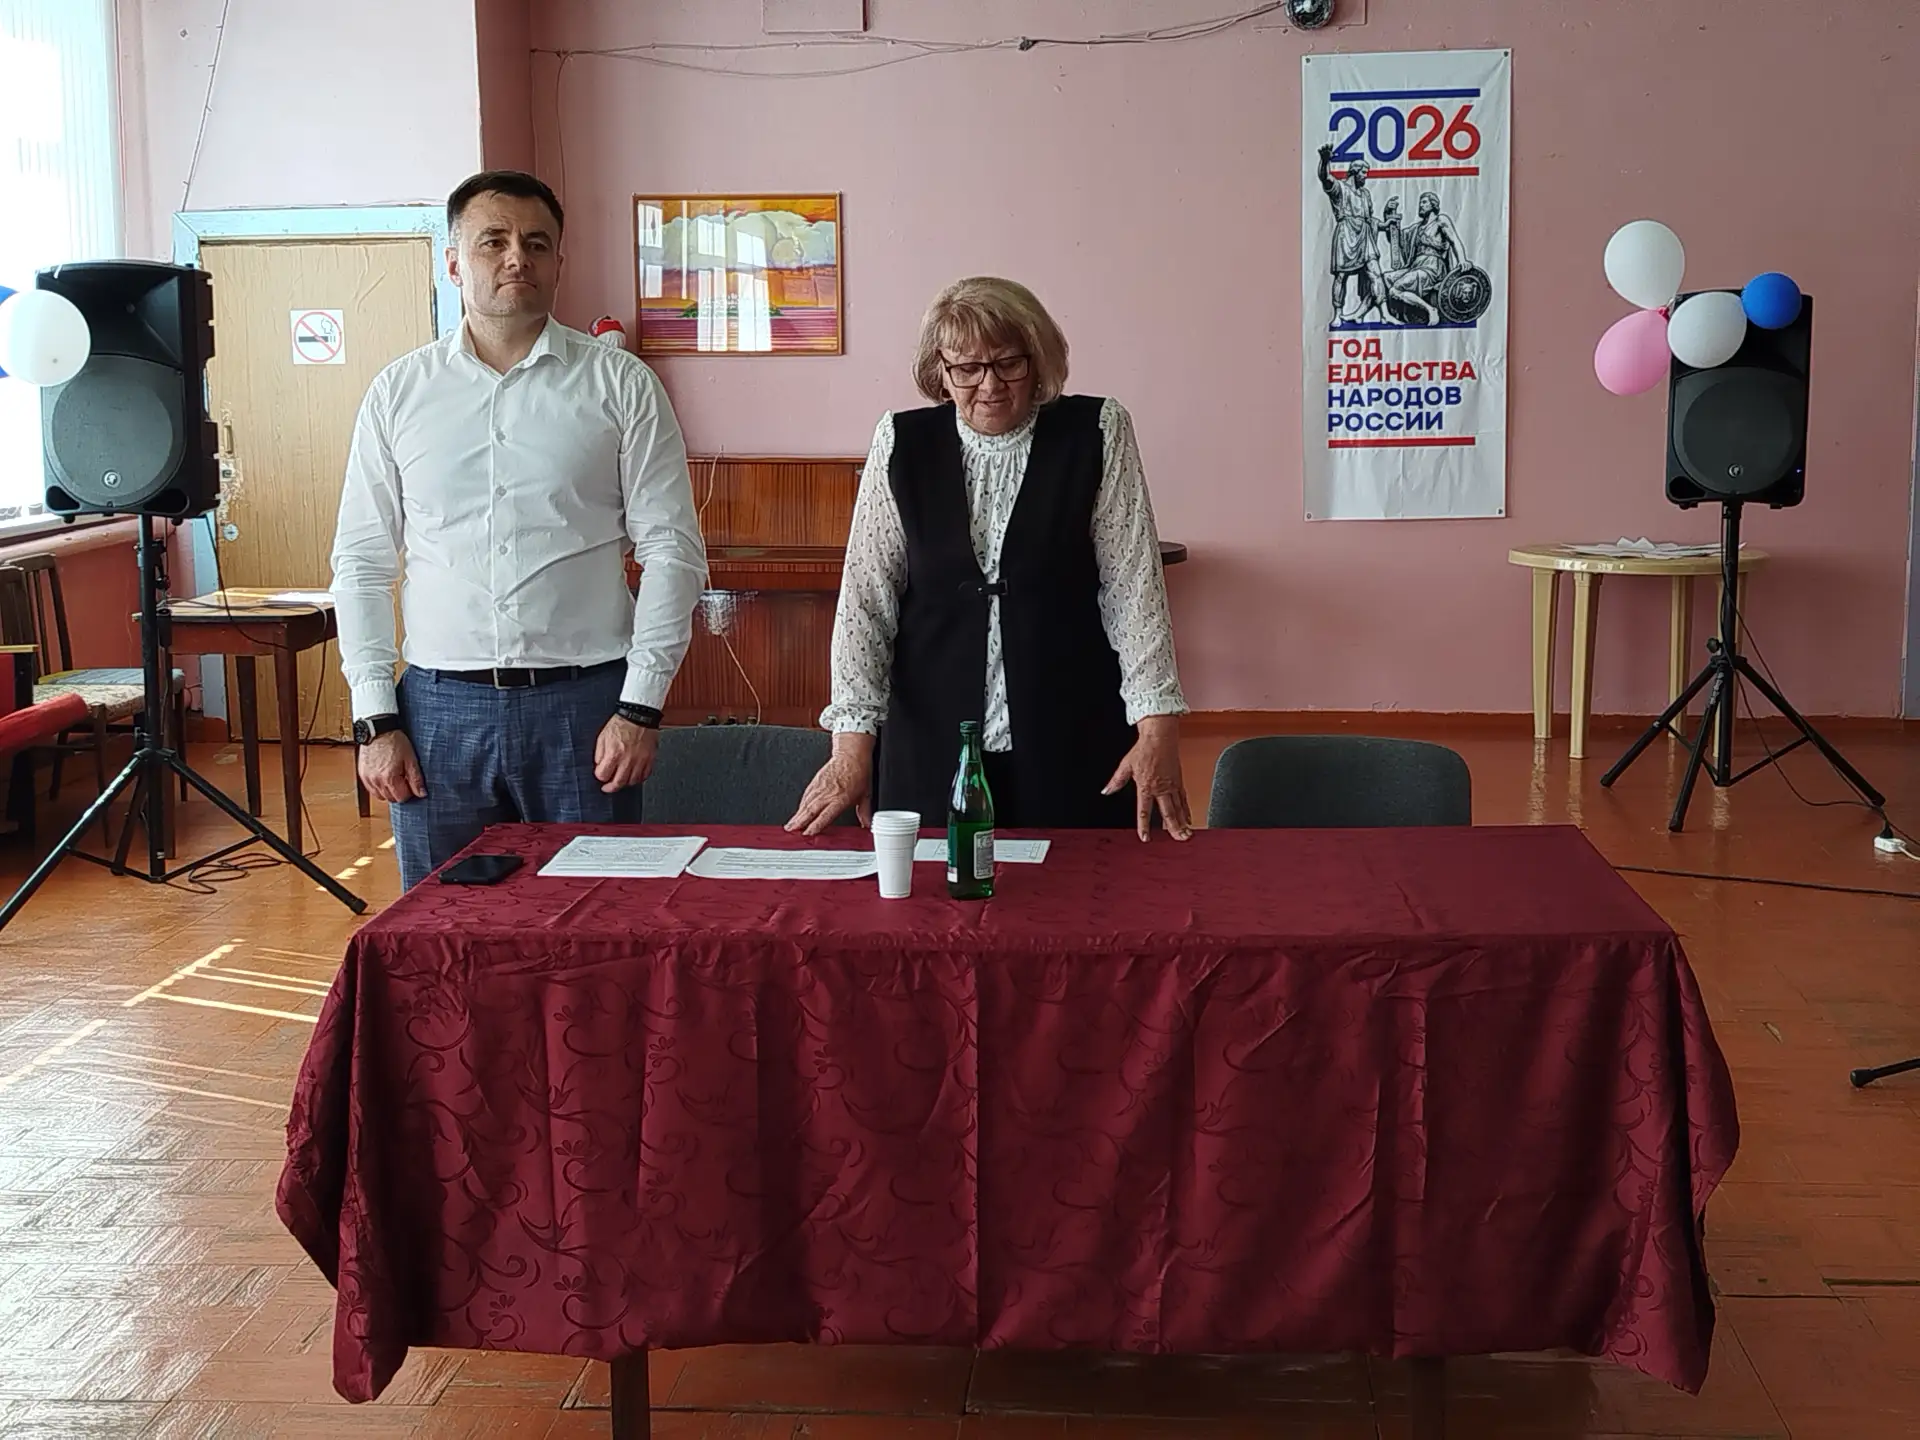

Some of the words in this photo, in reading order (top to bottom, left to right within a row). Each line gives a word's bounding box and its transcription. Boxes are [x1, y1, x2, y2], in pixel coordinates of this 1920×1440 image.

[1329, 104, 1481, 162] 2026
[1328, 338, 1382, 361] ГОД
[1328, 361, 1477, 385] ЕДИНСТВА
[1328, 386, 1462, 409] НАРОДОВ
[1328, 411, 1443, 432] РОССИИ
